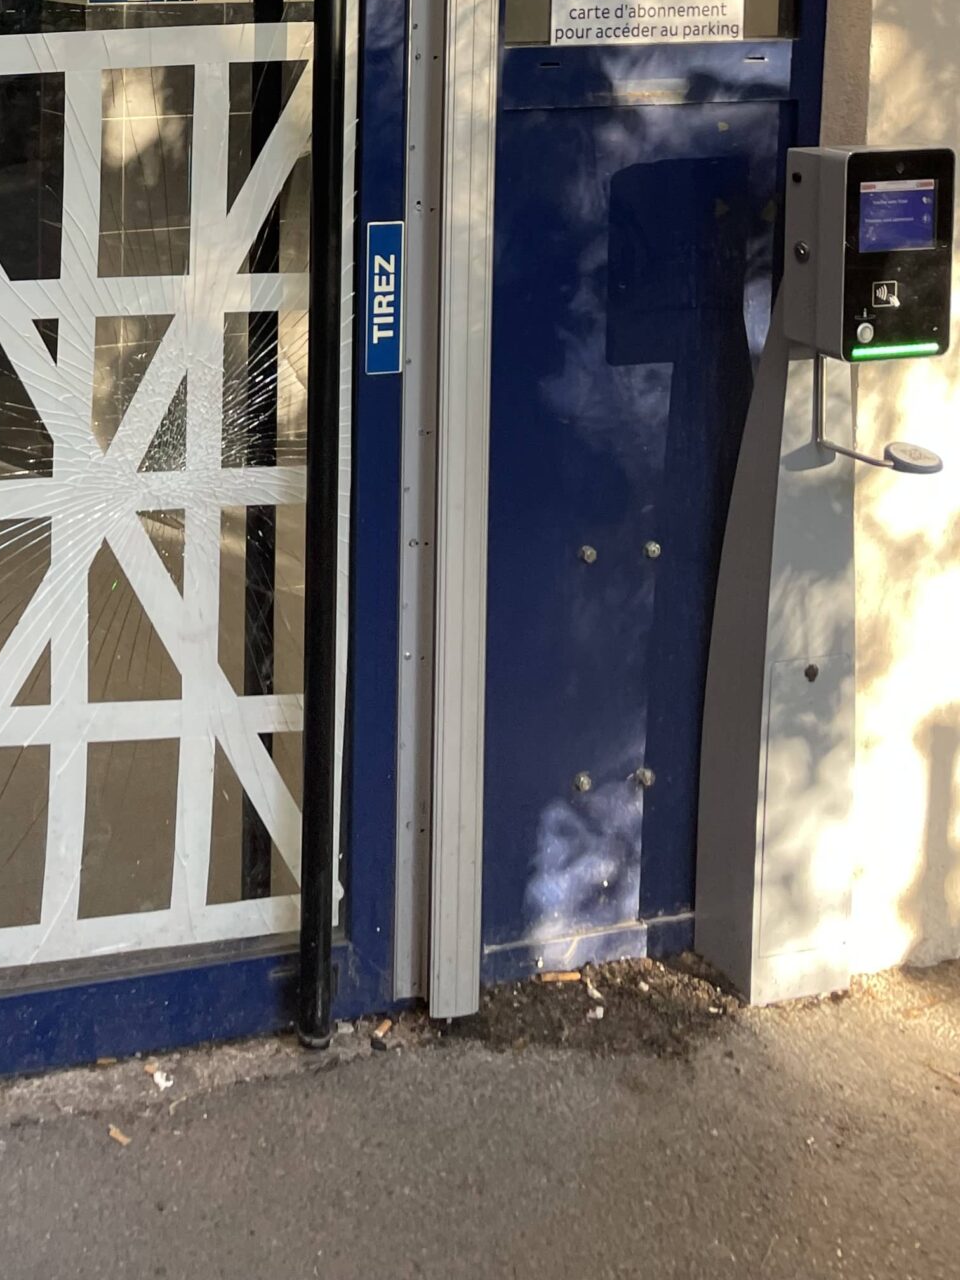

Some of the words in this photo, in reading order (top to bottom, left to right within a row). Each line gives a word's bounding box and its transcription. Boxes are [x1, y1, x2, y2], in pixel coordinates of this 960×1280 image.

[569, 6, 610, 20] carte
[614, 2, 727, 19] d'abonnement
[555, 26, 592, 43] pour
[595, 23, 657, 40] accéder
[660, 25, 678, 37] au
[683, 22, 740, 40] parking
[373, 254, 396, 344] TIREZ
